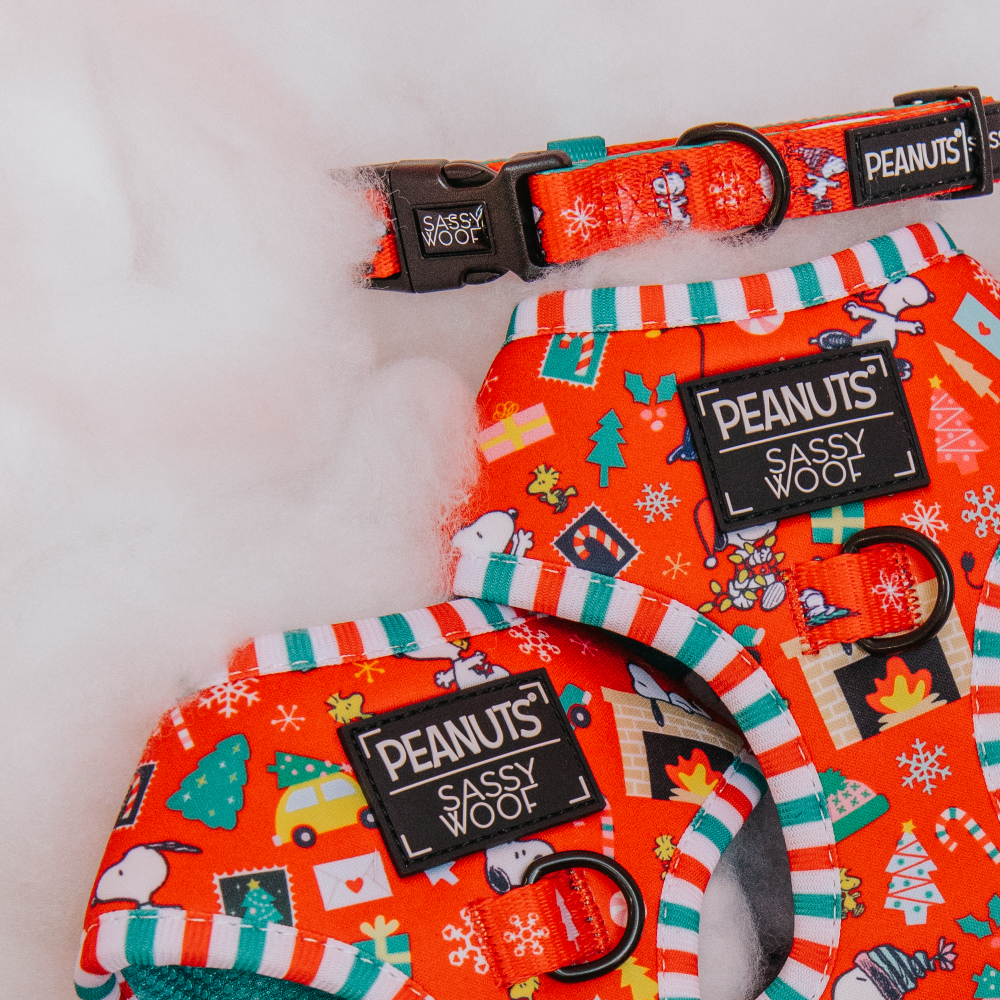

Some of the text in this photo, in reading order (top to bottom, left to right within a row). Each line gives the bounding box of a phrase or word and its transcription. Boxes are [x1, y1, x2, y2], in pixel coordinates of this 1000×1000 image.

[421, 227, 482, 247] WOOF
[423, 205, 483, 232] SASSY
[766, 428, 865, 474] SASSY
[764, 453, 866, 500] WOOF
[438, 757, 535, 812] SASSY
[438, 783, 539, 838] WOOF
